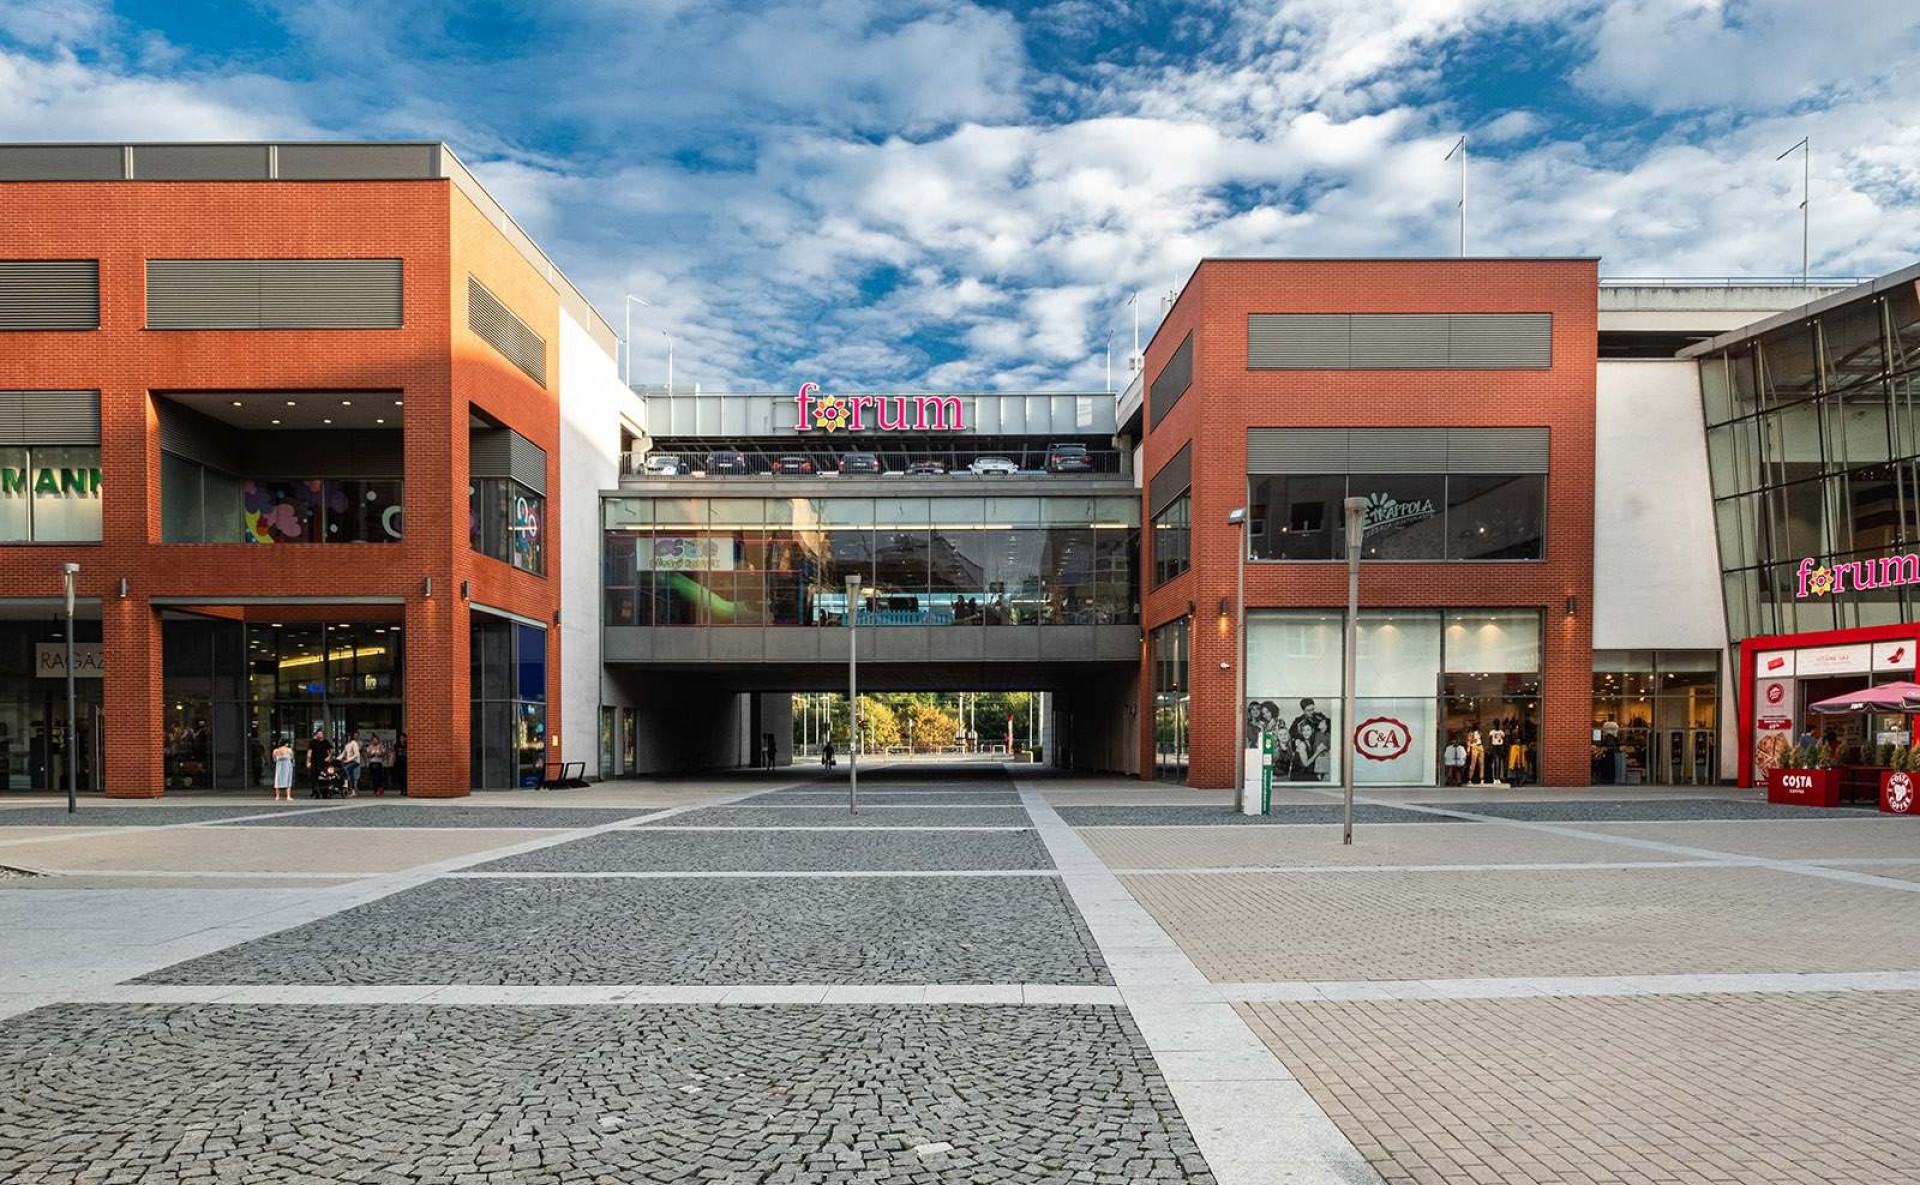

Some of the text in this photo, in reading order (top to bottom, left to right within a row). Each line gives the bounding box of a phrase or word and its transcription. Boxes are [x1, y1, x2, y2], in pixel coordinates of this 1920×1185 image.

[795, 382, 967, 432] forum
[1797, 554, 1920, 597] forum
[1363, 729, 1401, 748] C&A
[1783, 775, 1813, 789] COSTA
